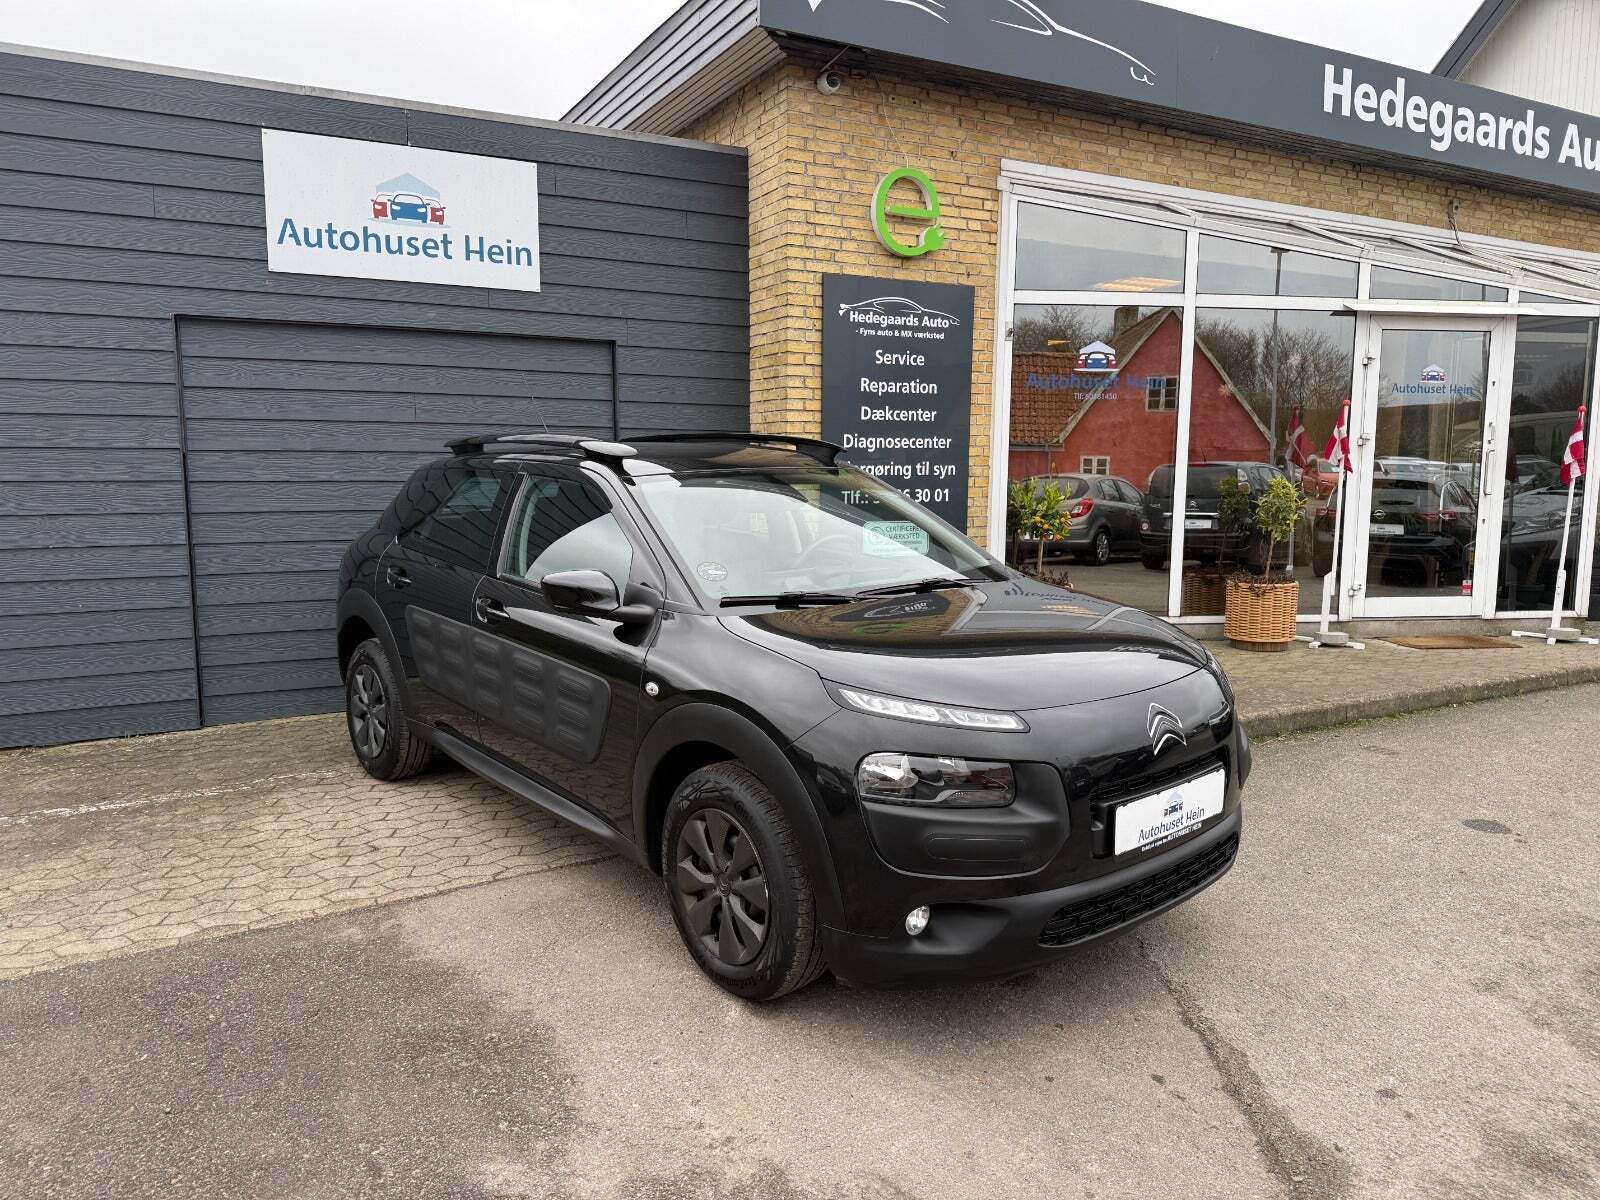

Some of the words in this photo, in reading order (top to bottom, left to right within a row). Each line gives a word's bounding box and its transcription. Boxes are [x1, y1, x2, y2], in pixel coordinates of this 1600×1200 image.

[1323, 63, 1551, 160] Hedegaards
[277, 218, 453, 260] Autohuset
[465, 234, 533, 267] Hein
[850, 311, 919, 327] Hedegaards
[921, 316, 950, 328] Auto
[860, 328, 875, 337] Fyns
[901, 330, 912, 338] MX
[914, 331, 945, 340] værksted
[875, 350, 925, 366] Service
[860, 377, 938, 396] Reparation
[1025, 372, 1121, 390] Autohuset
[1391, 383, 1447, 394] Autohuset
[1450, 384, 1473, 395] Hein
[861, 406, 937, 423] Dækcenter
[843, 433, 952, 453] Diagnosecenter
[847, 461, 912, 479] rgøring
[916, 461, 929, 476] til
[933, 464, 956, 480] syn
[841, 490, 868, 505] Tlf.:
[915, 488, 931, 503] 30
[934, 488, 950, 502] 01
[1137, 814, 1184, 843] Autohuset
[1185, 807, 1205, 824] Hein
